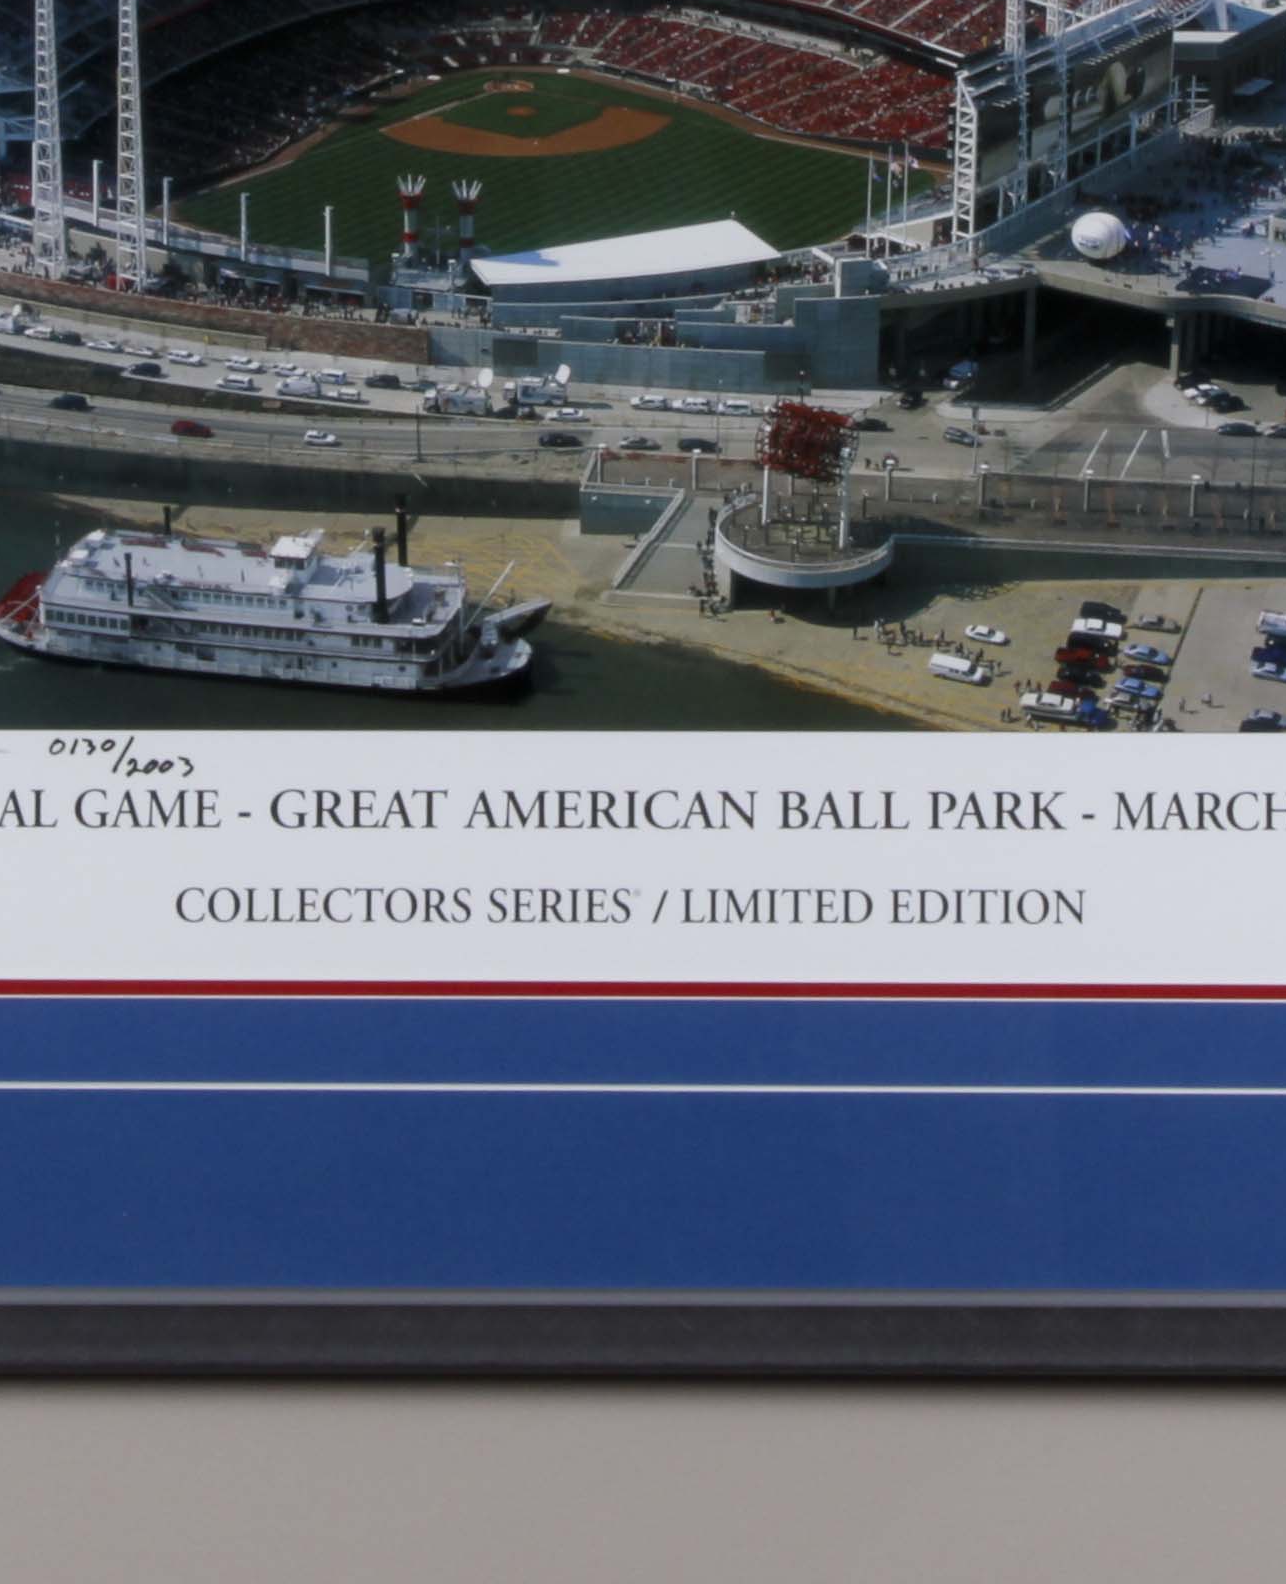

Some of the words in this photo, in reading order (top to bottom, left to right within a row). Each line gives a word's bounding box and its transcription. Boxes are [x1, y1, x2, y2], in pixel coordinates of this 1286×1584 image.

[73, 788, 222, 829] GAME
[269, 789, 449, 830] GREAT
[464, 789, 758, 830] AMERICAN
[778, 790, 910, 831] BALL
[927, 790, 1067, 831] PARK
[174, 886, 473, 924] COLLECTORS
[682, 888, 875, 925] LIMITED
[889, 889, 1086, 926] EDITION
